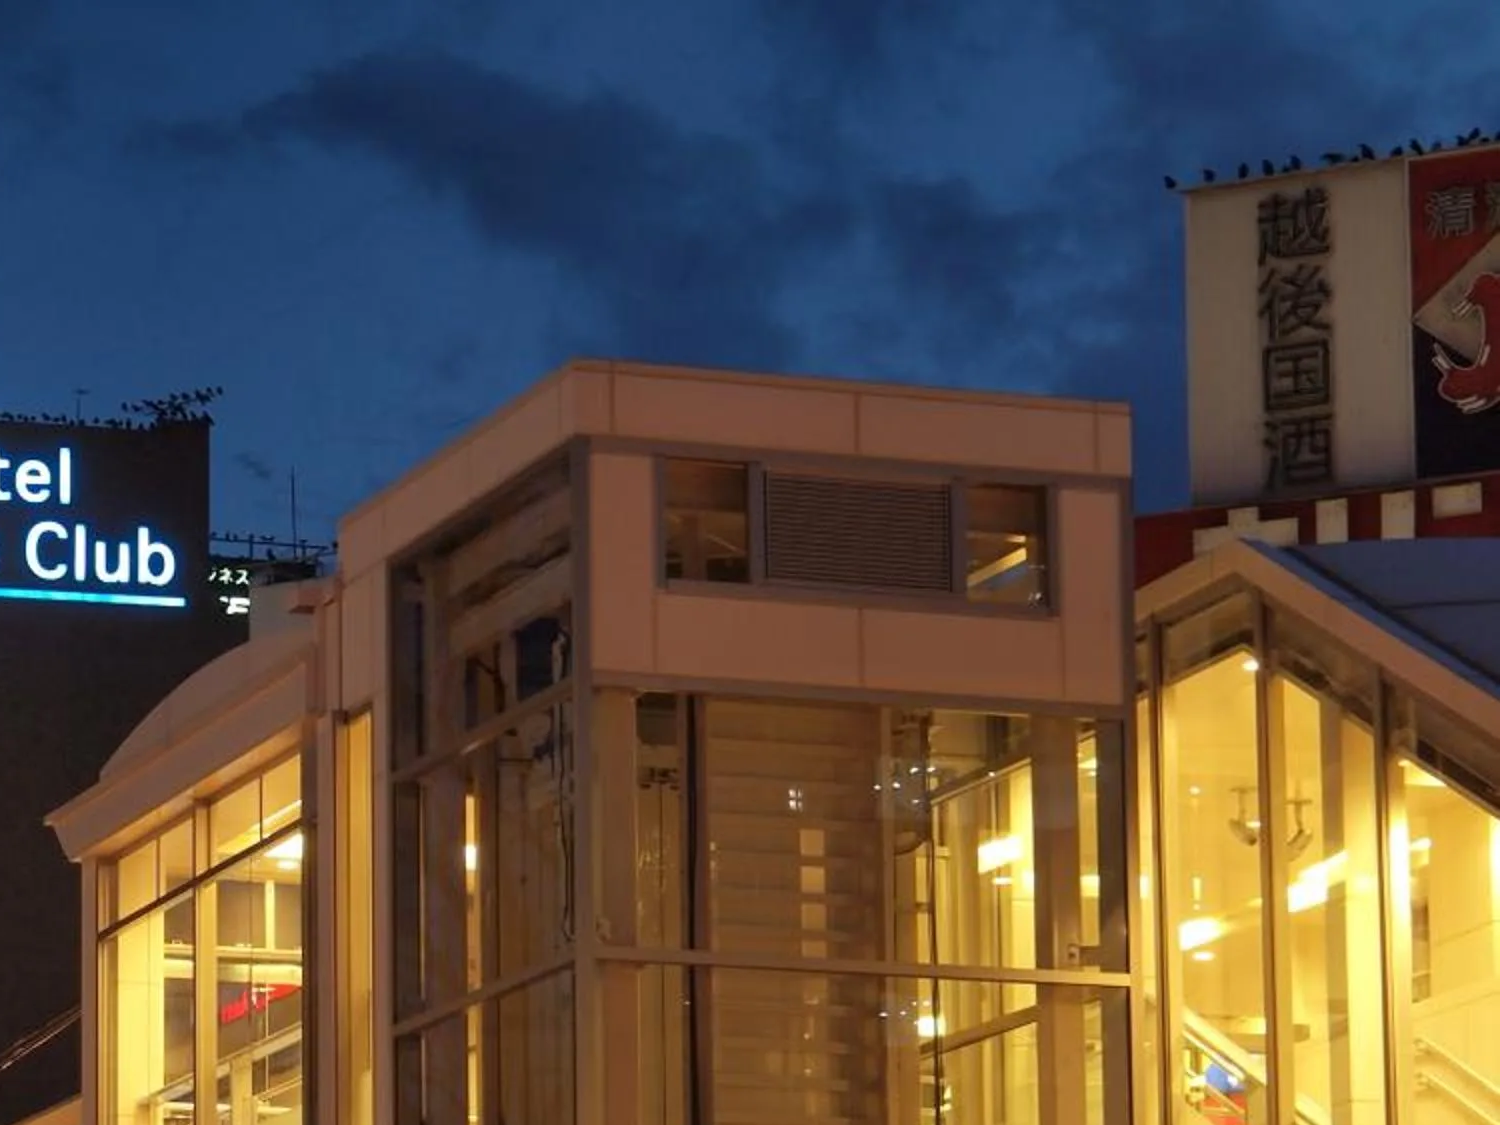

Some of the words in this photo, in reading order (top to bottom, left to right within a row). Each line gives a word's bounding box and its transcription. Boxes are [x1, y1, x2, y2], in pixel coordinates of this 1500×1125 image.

[1257, 187, 1333, 493] 越後国酒
[25, 522, 176, 586] Club
